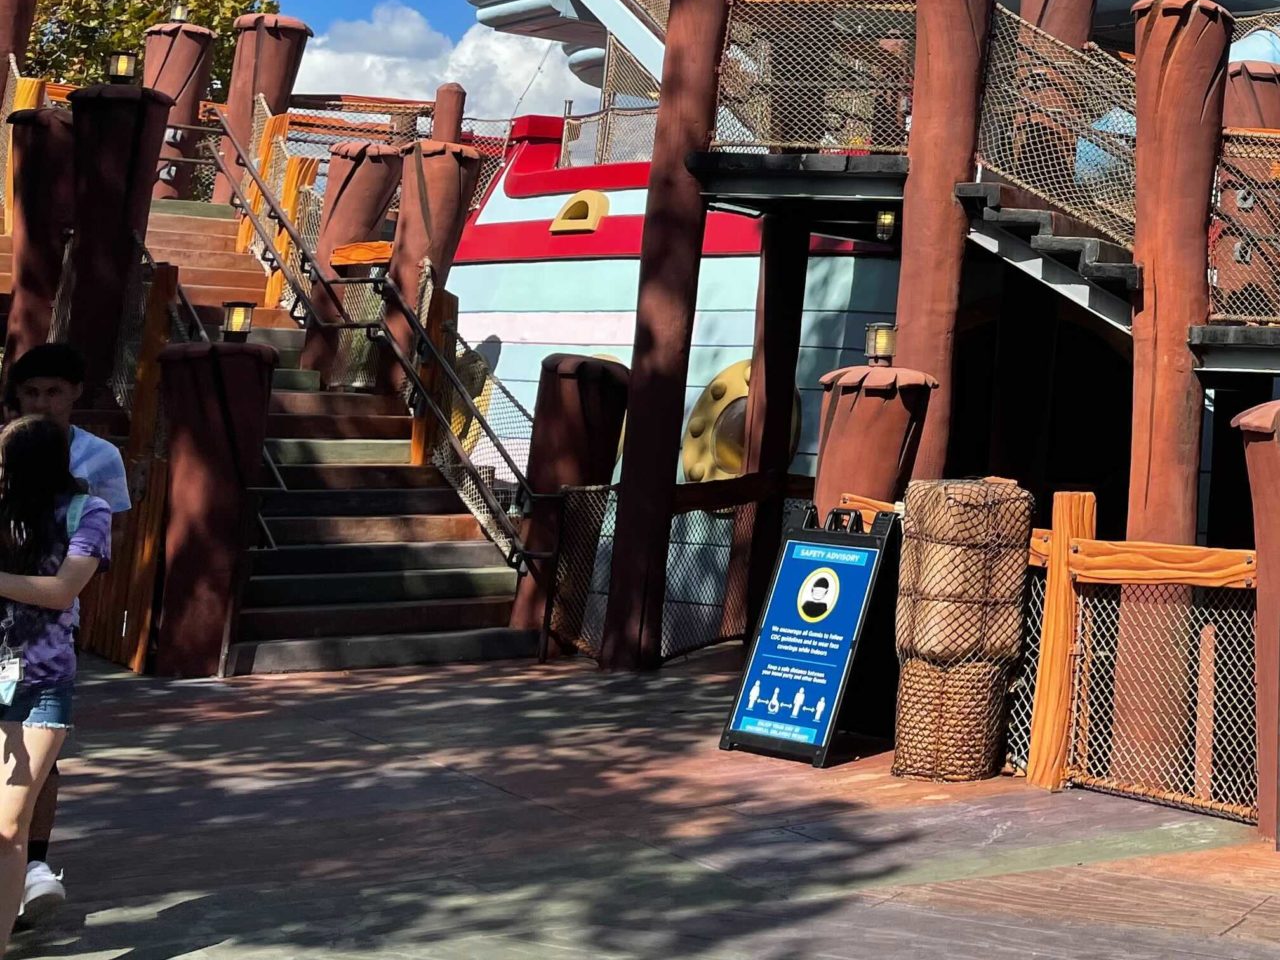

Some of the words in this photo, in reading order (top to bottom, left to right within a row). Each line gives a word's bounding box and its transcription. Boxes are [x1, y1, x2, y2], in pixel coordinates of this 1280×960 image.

[800, 549, 825, 558] SAFETY
[826, 552, 860, 562] ADVISORY
[781, 636, 803, 644] guidelines
[777, 644, 798, 652] coverings
